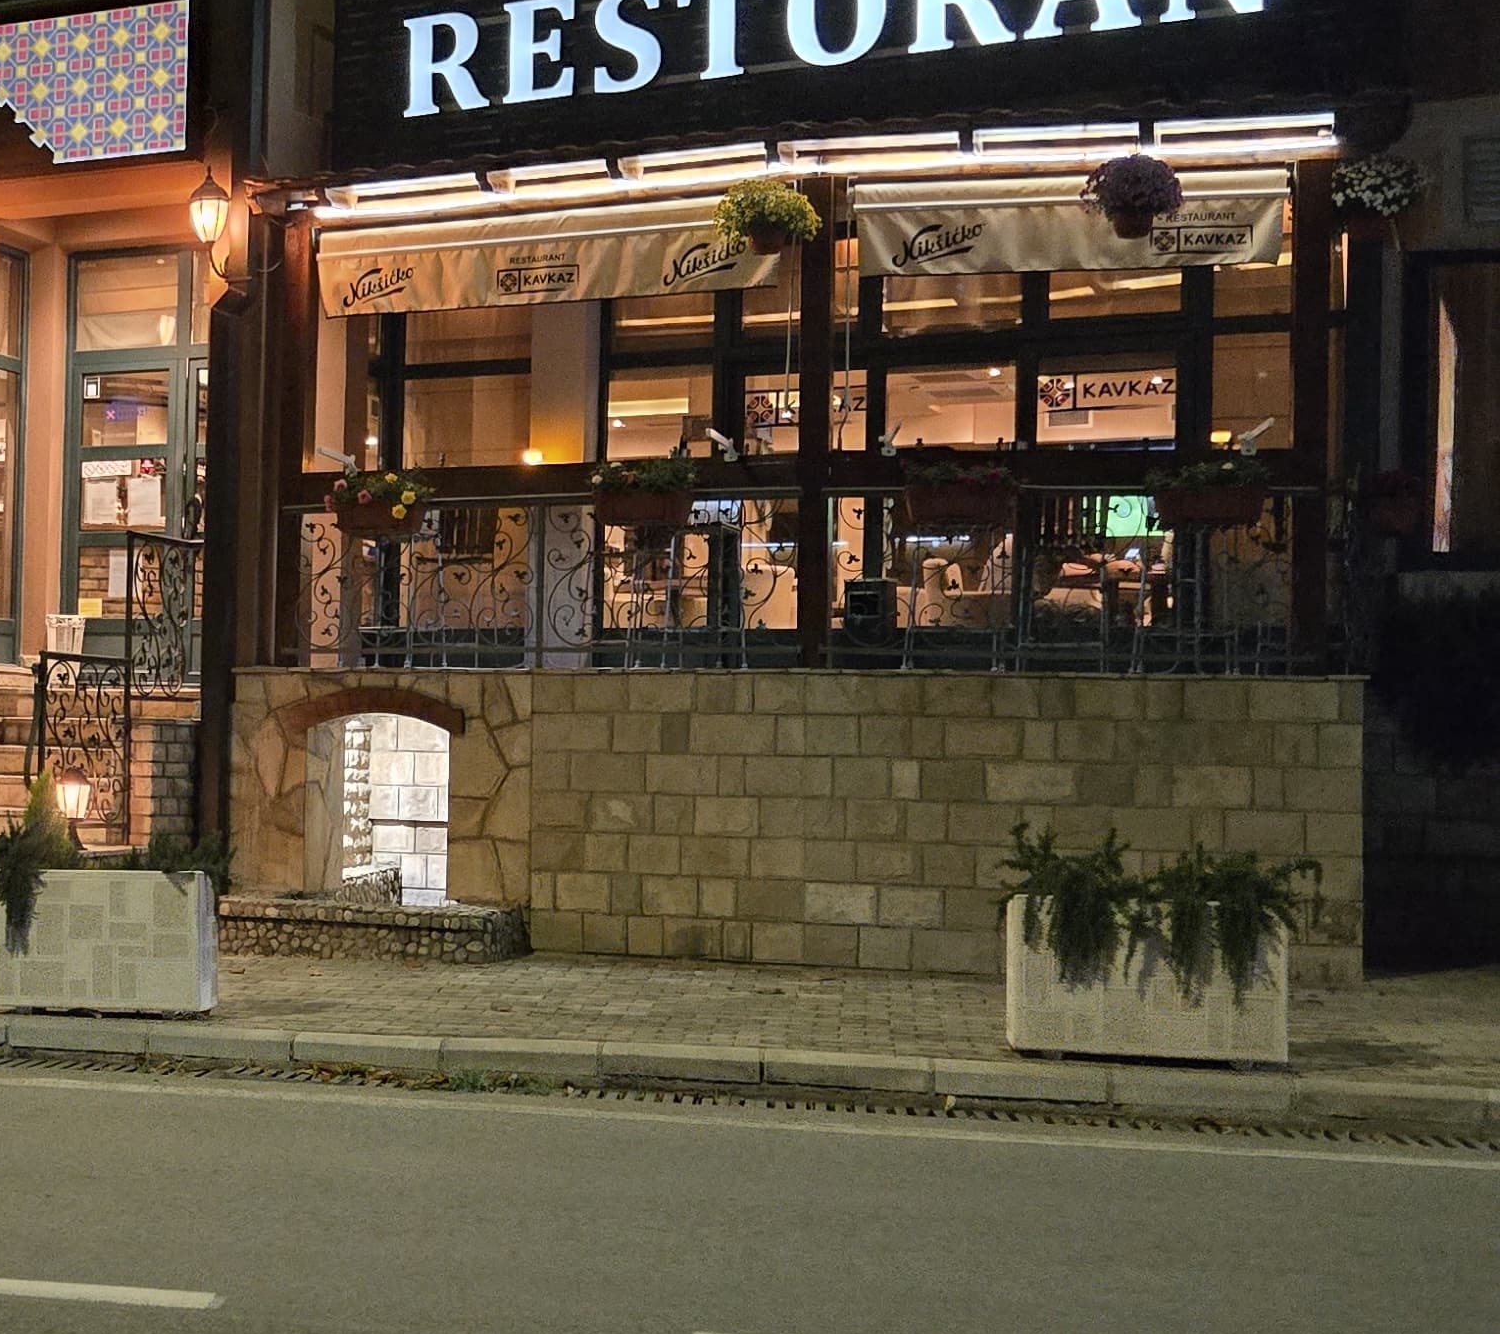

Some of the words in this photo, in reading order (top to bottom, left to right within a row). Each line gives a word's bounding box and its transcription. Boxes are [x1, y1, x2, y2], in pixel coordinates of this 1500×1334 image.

[1165, 211, 1236, 222] RESTAURANT
[892, 224, 983, 267] Nikšićko
[1183, 233, 1248, 247] KAVKAZ
[509, 253, 567, 265] RESTAURANT
[523, 271, 575, 287] KAVKAZ
[1082, 378, 1176, 399] KAVKAZ
